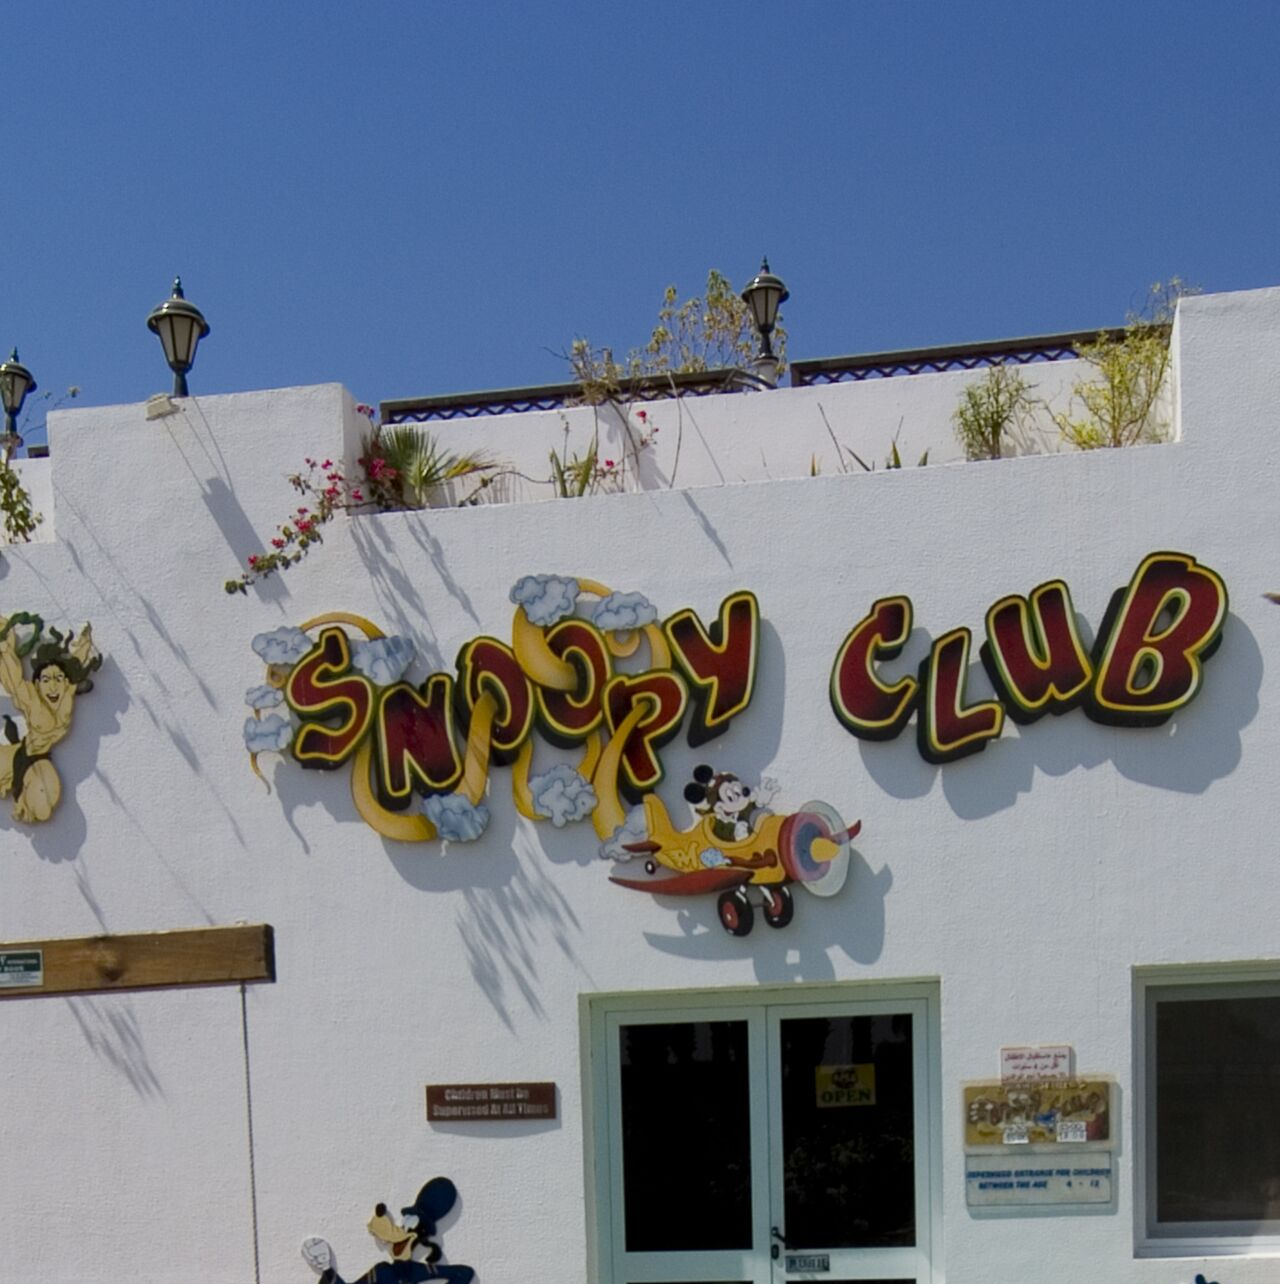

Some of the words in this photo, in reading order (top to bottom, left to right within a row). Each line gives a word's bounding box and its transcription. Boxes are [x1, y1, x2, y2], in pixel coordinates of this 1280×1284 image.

[286, 588, 760, 803] SNOOPY
[830, 551, 1228, 760] CLUB
[821, 1087, 871, 1103] OPEN
